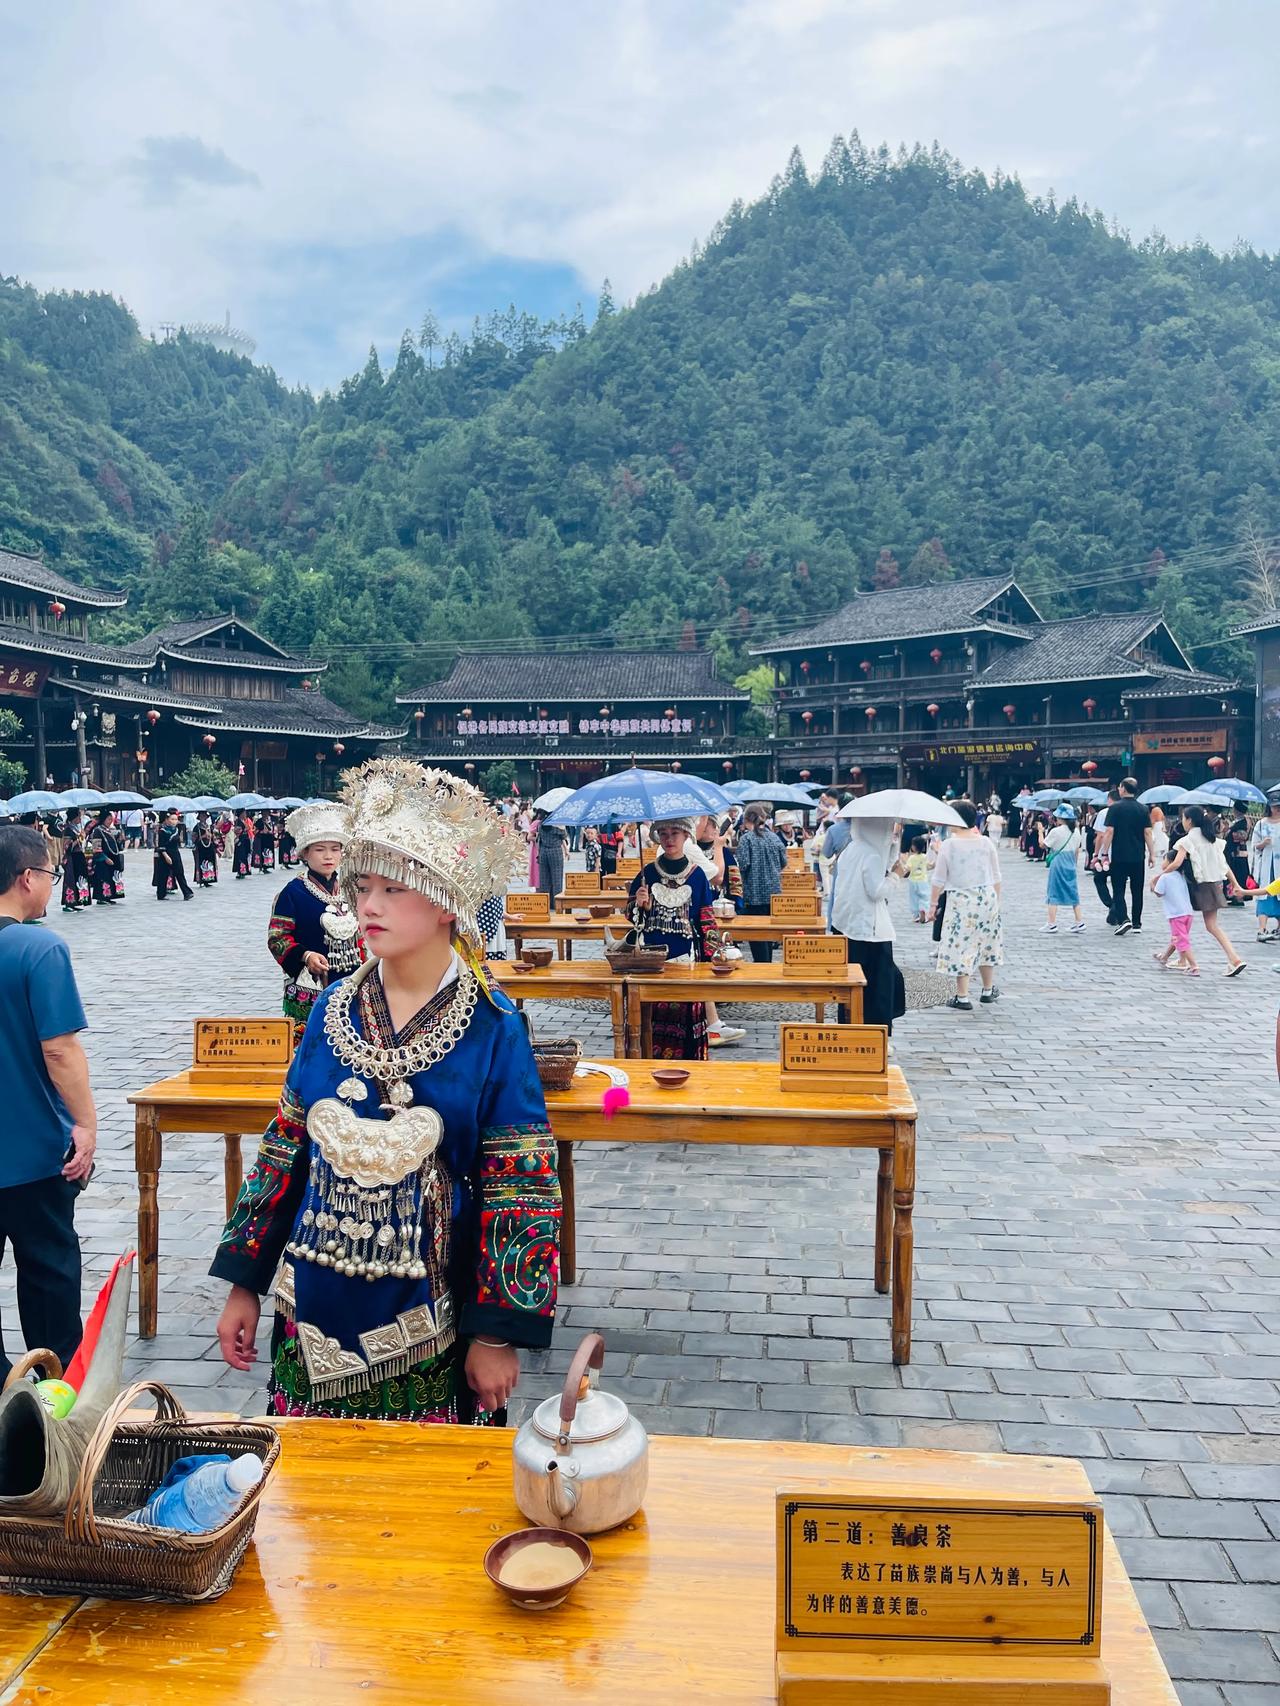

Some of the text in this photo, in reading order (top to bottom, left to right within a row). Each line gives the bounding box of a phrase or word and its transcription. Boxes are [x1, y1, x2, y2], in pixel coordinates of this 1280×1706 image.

[802, 1520, 952, 1548] 第二道：善良茶
[840, 1562, 1070, 1588] 表达了苗族崇尚与人为善，与人
[806, 1594, 928, 1617] 为伴的善意美德。
